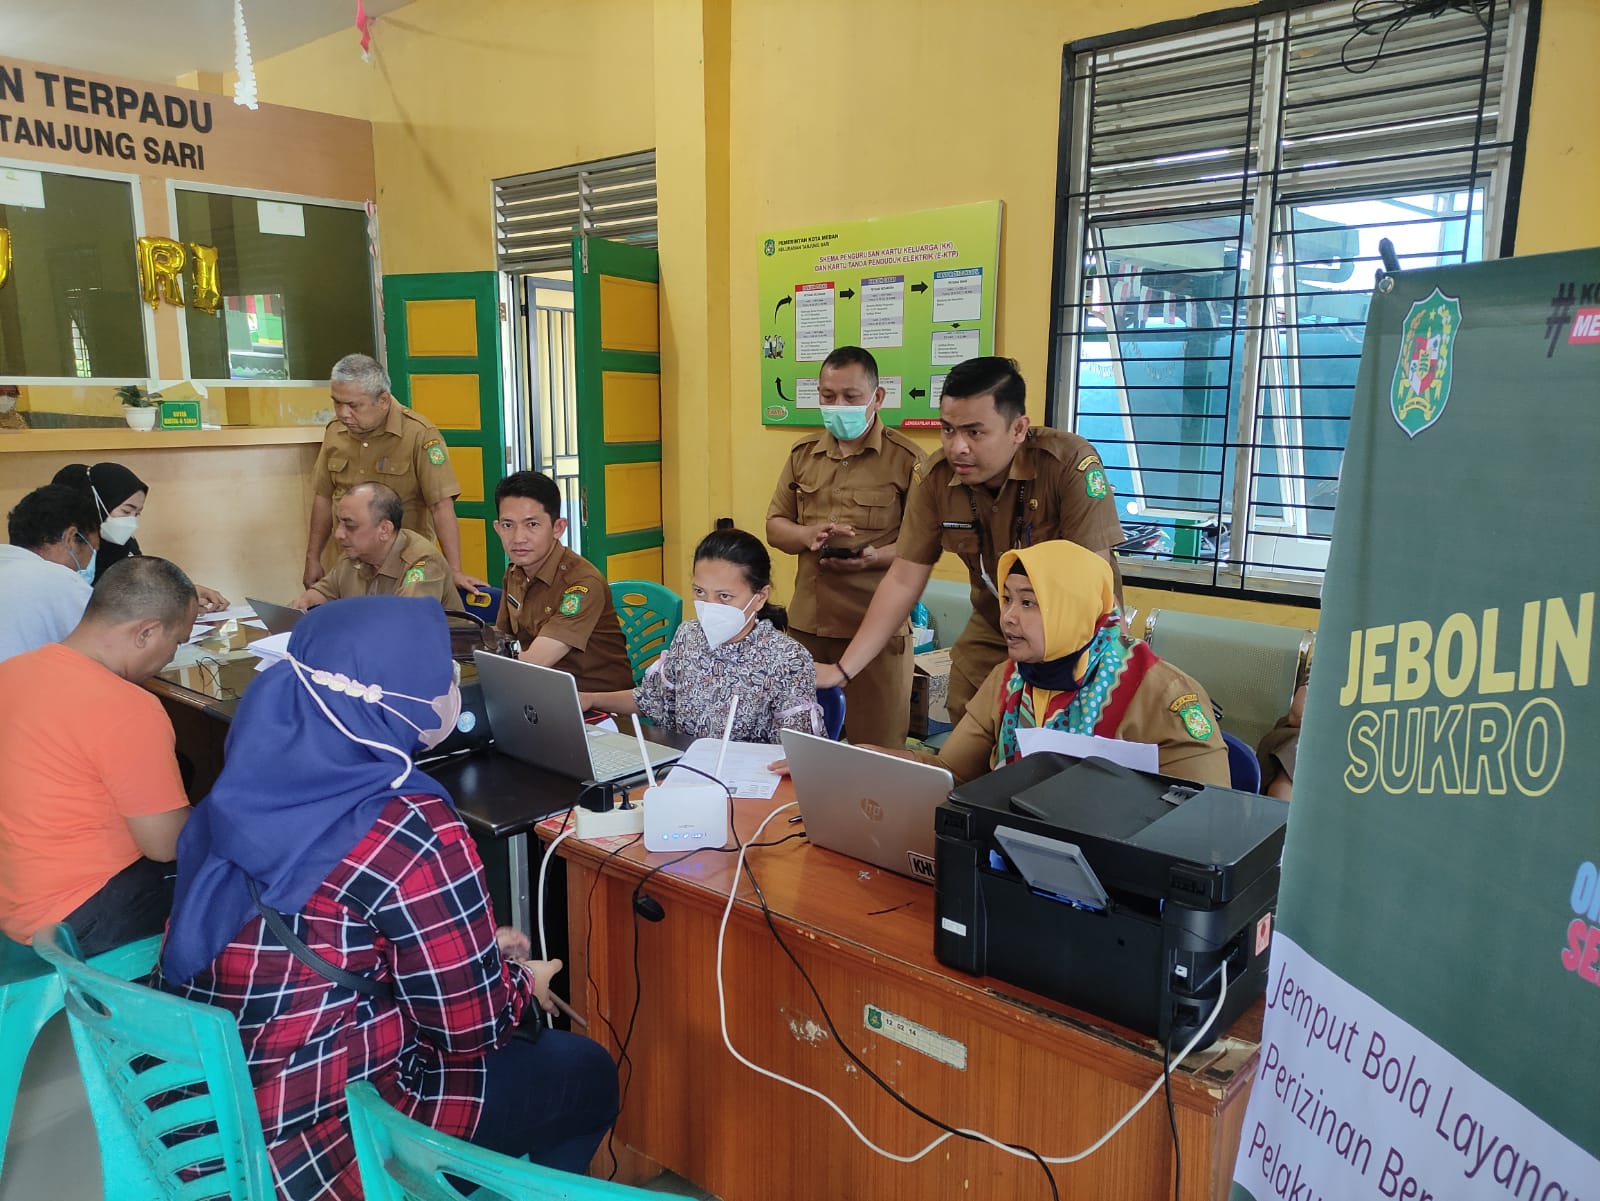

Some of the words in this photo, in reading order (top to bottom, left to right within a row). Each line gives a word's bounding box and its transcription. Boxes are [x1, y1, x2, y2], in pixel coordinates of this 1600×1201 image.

[35, 71, 212, 133] TERPADU
[143, 136, 205, 170] SARI
[819, 255, 839, 263] SKEMA
[840, 250, 880, 261] PENGURUSAN
[881, 248, 902, 257] KARTU
[903, 243, 938, 254] KELUARGA
[828, 262, 847, 271] KARTU
[848, 260, 867, 269] TANDA
[868, 256, 901, 266] PENDUDUK
[902, 253, 933, 263] ELEKTRIK
[1340, 592, 1595, 706] JEBOLIN
[1344, 696, 1566, 797] SUKRO
[1267, 962, 1359, 1063] Jemput
[1362, 1031, 1431, 1119] Bola
[1261, 1042, 1373, 1176] Perizinan
